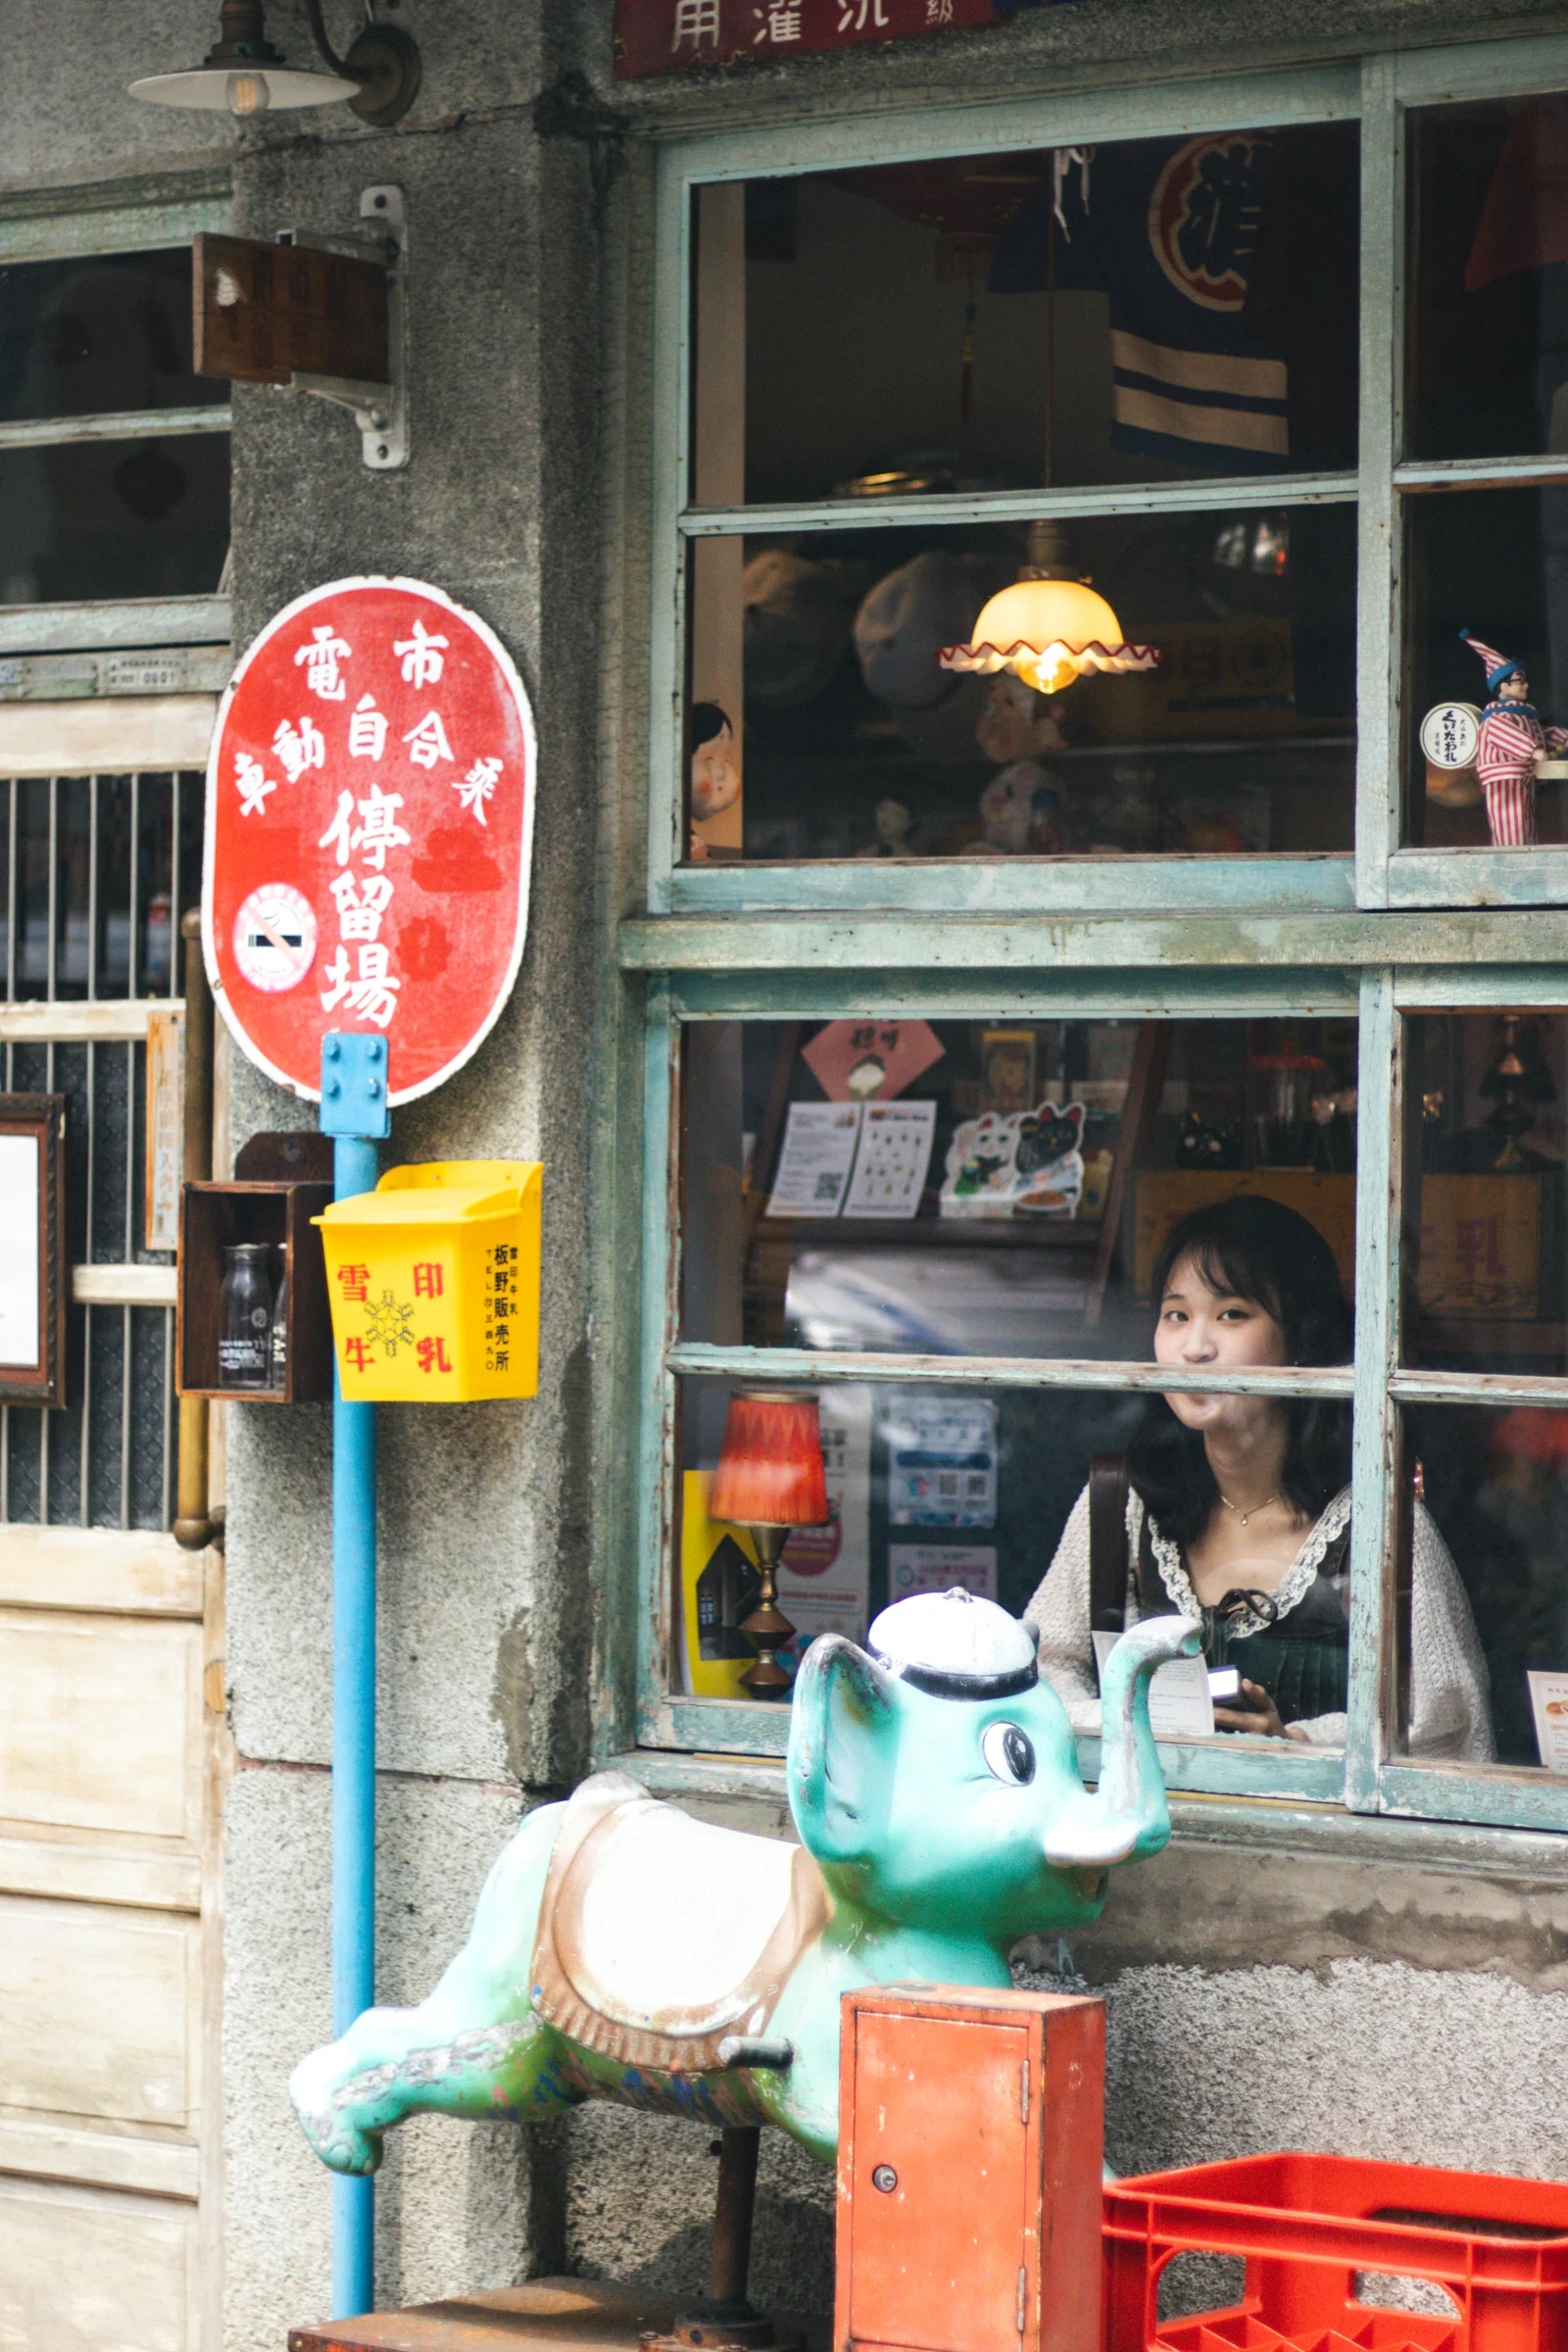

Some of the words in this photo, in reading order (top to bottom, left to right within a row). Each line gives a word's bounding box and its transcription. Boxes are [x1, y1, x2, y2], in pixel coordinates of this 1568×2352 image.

[318, 783, 412, 1028] 停留場
[494, 1244, 510, 1372] 板野販売所
